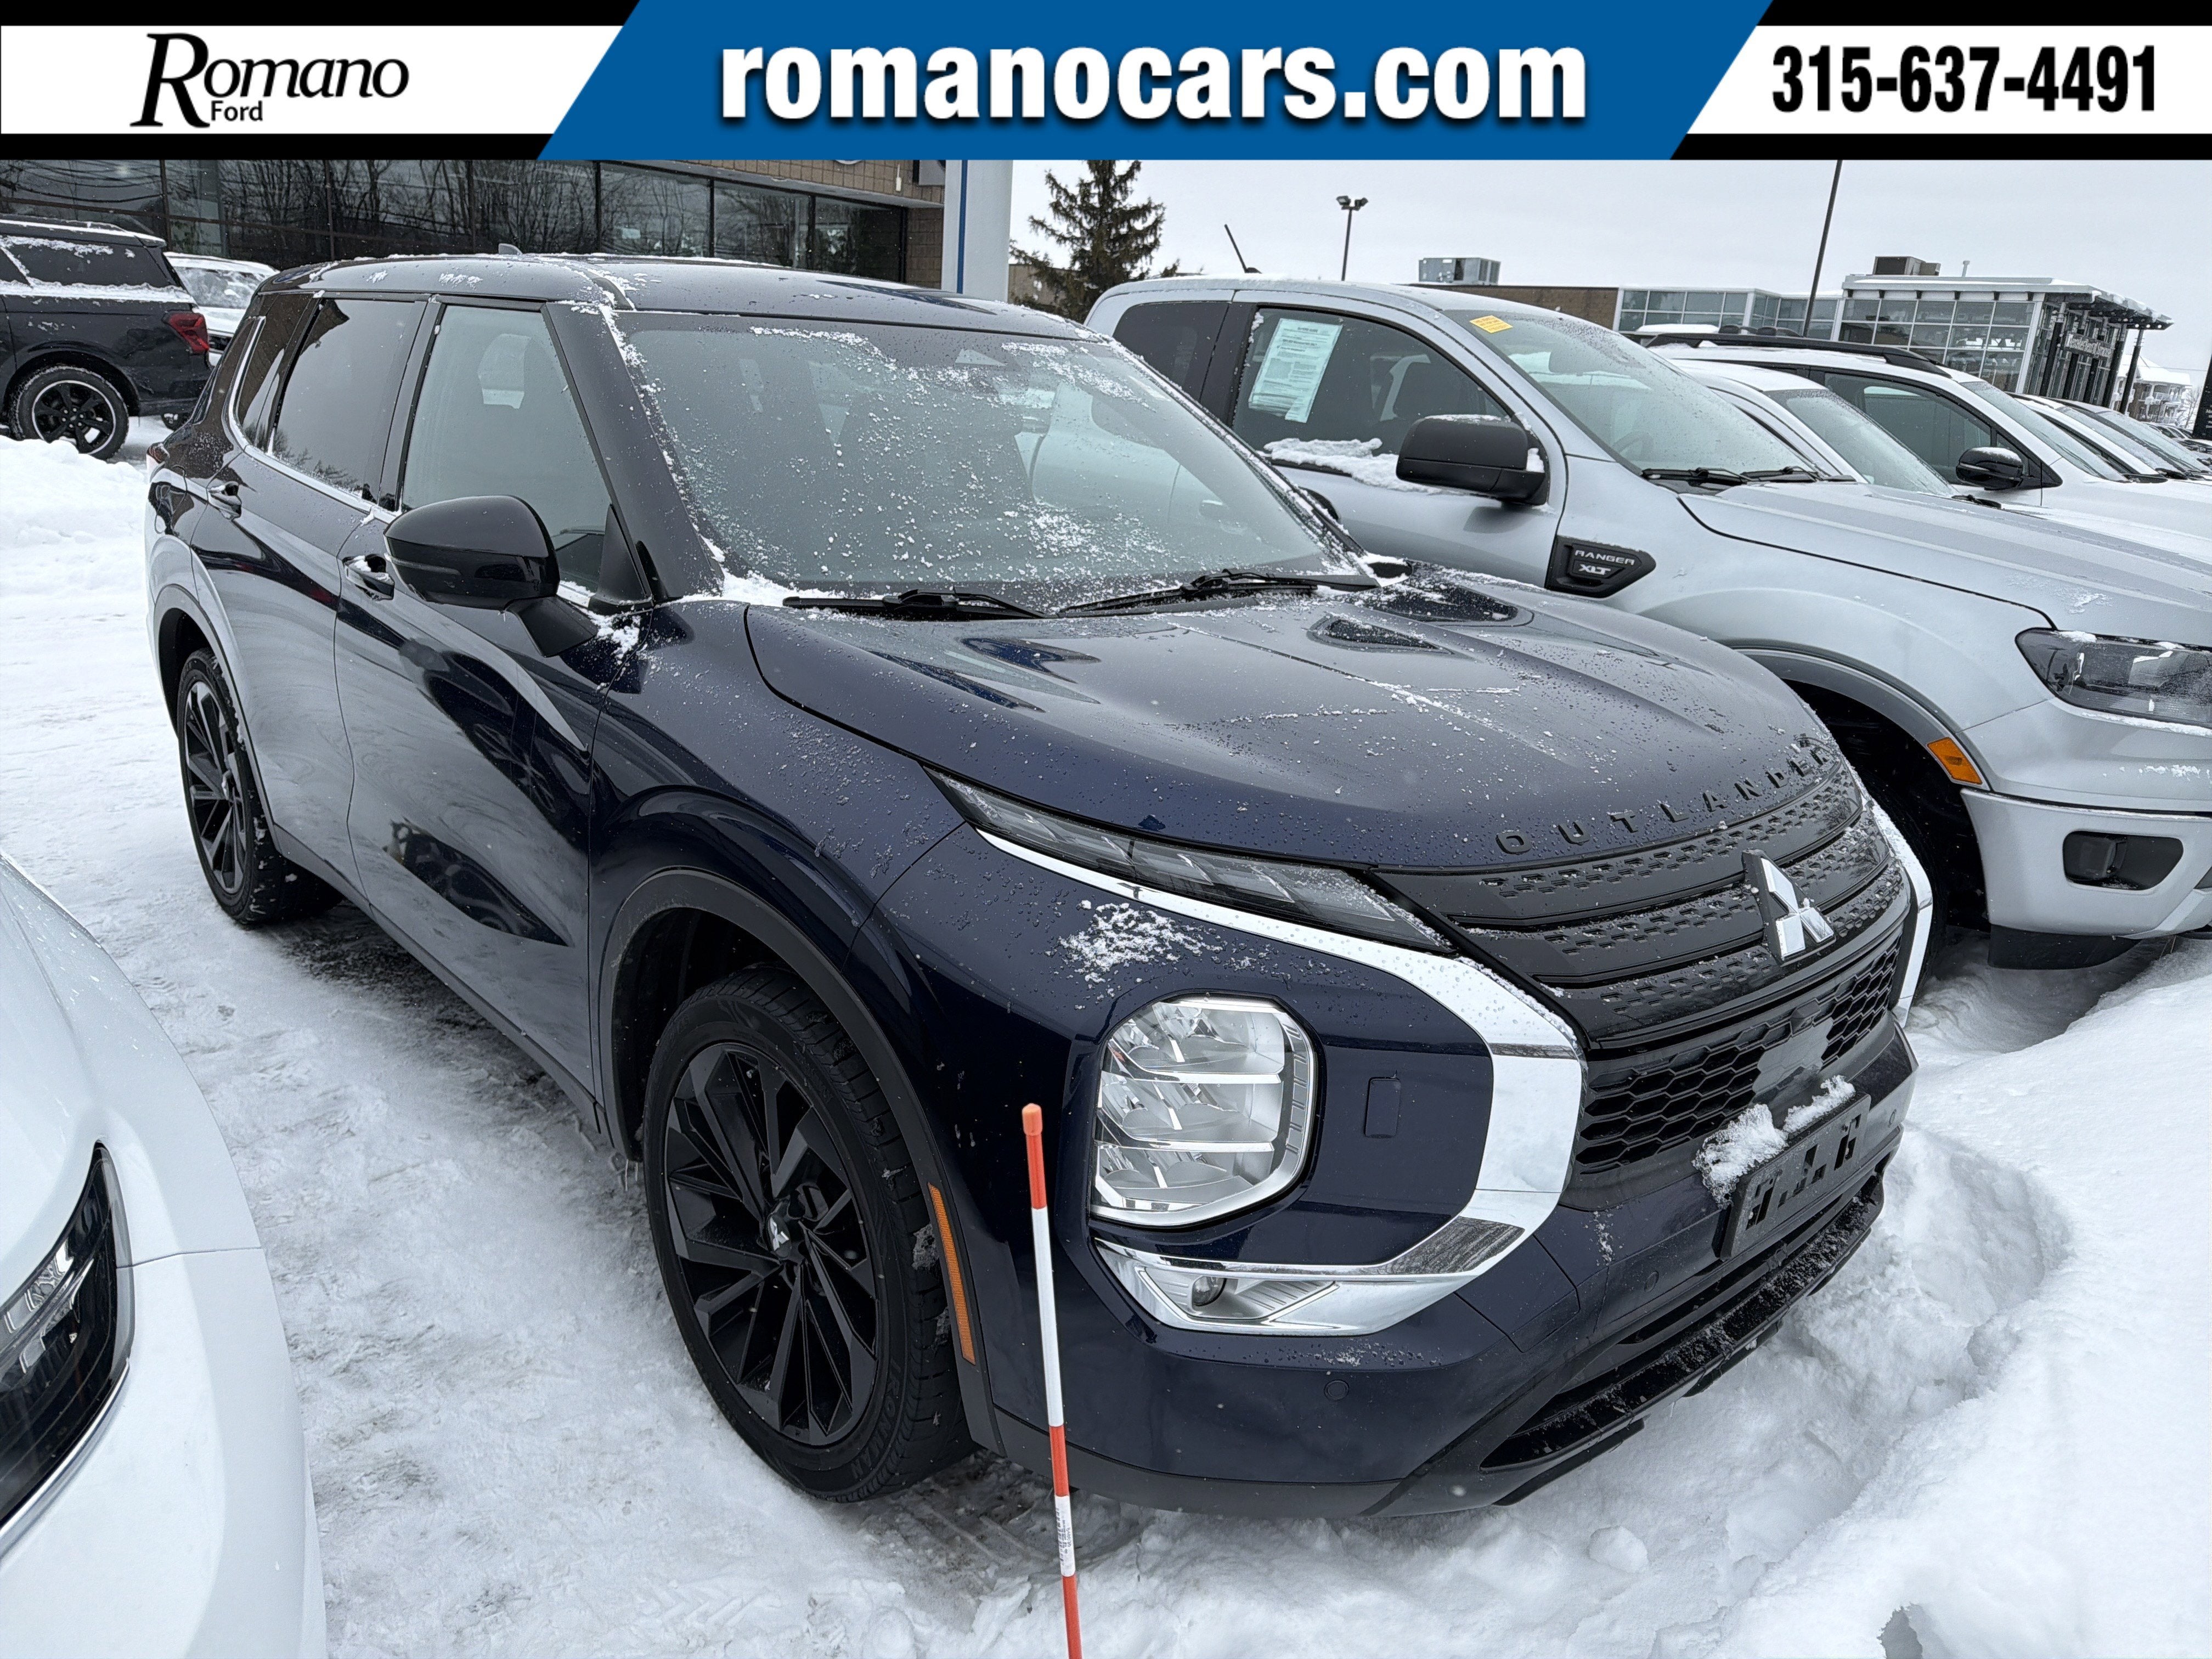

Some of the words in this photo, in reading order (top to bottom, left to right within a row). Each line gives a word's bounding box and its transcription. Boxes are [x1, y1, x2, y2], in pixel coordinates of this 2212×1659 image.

[1575, 550, 1635, 566] RANGER
[1578, 563, 1611, 575] XLT
[1496, 746, 1831, 856] OUTLANDER
